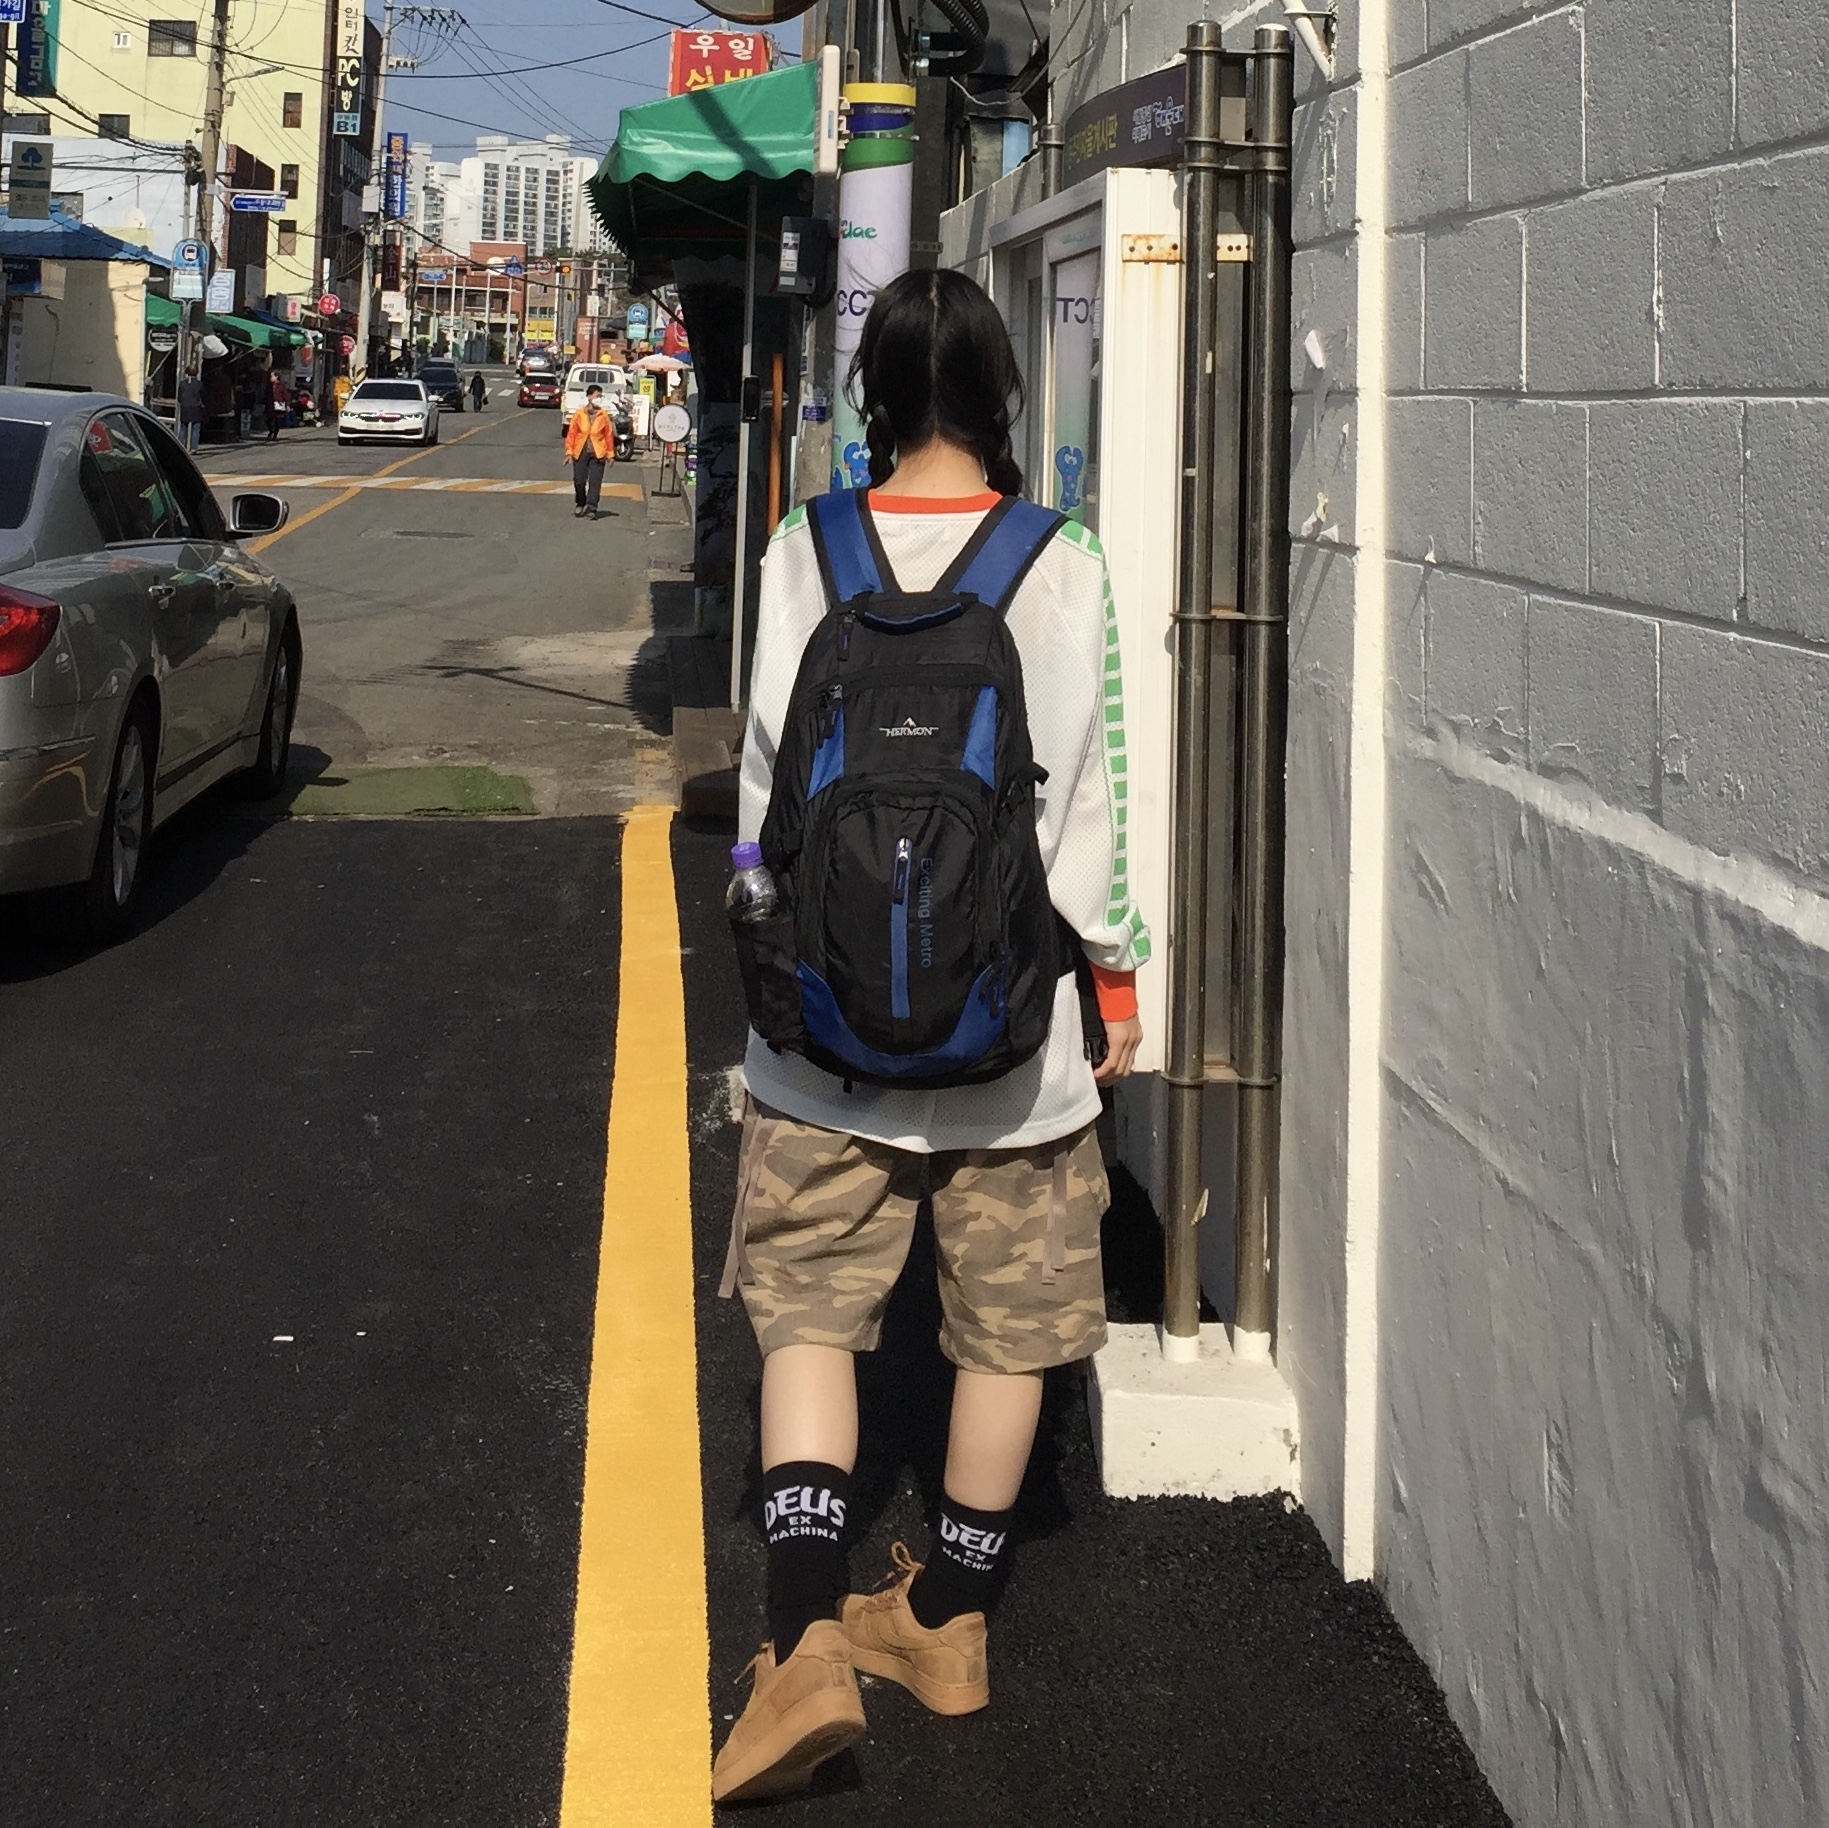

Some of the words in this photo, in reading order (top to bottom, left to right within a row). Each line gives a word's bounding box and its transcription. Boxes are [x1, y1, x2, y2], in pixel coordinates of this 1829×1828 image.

[689, 34, 754, 61] 우일
[336, 121, 357, 133] B1
[879, 726, 939, 737] HERMON
[918, 858, 932, 918] Exciting
[920, 924, 933, 968] Metro
[765, 1485, 846, 1531] DEUS
[788, 1515, 812, 1525] EX
[769, 1526, 838, 1544] MACHINA
[965, 1549, 986, 1562] EX
